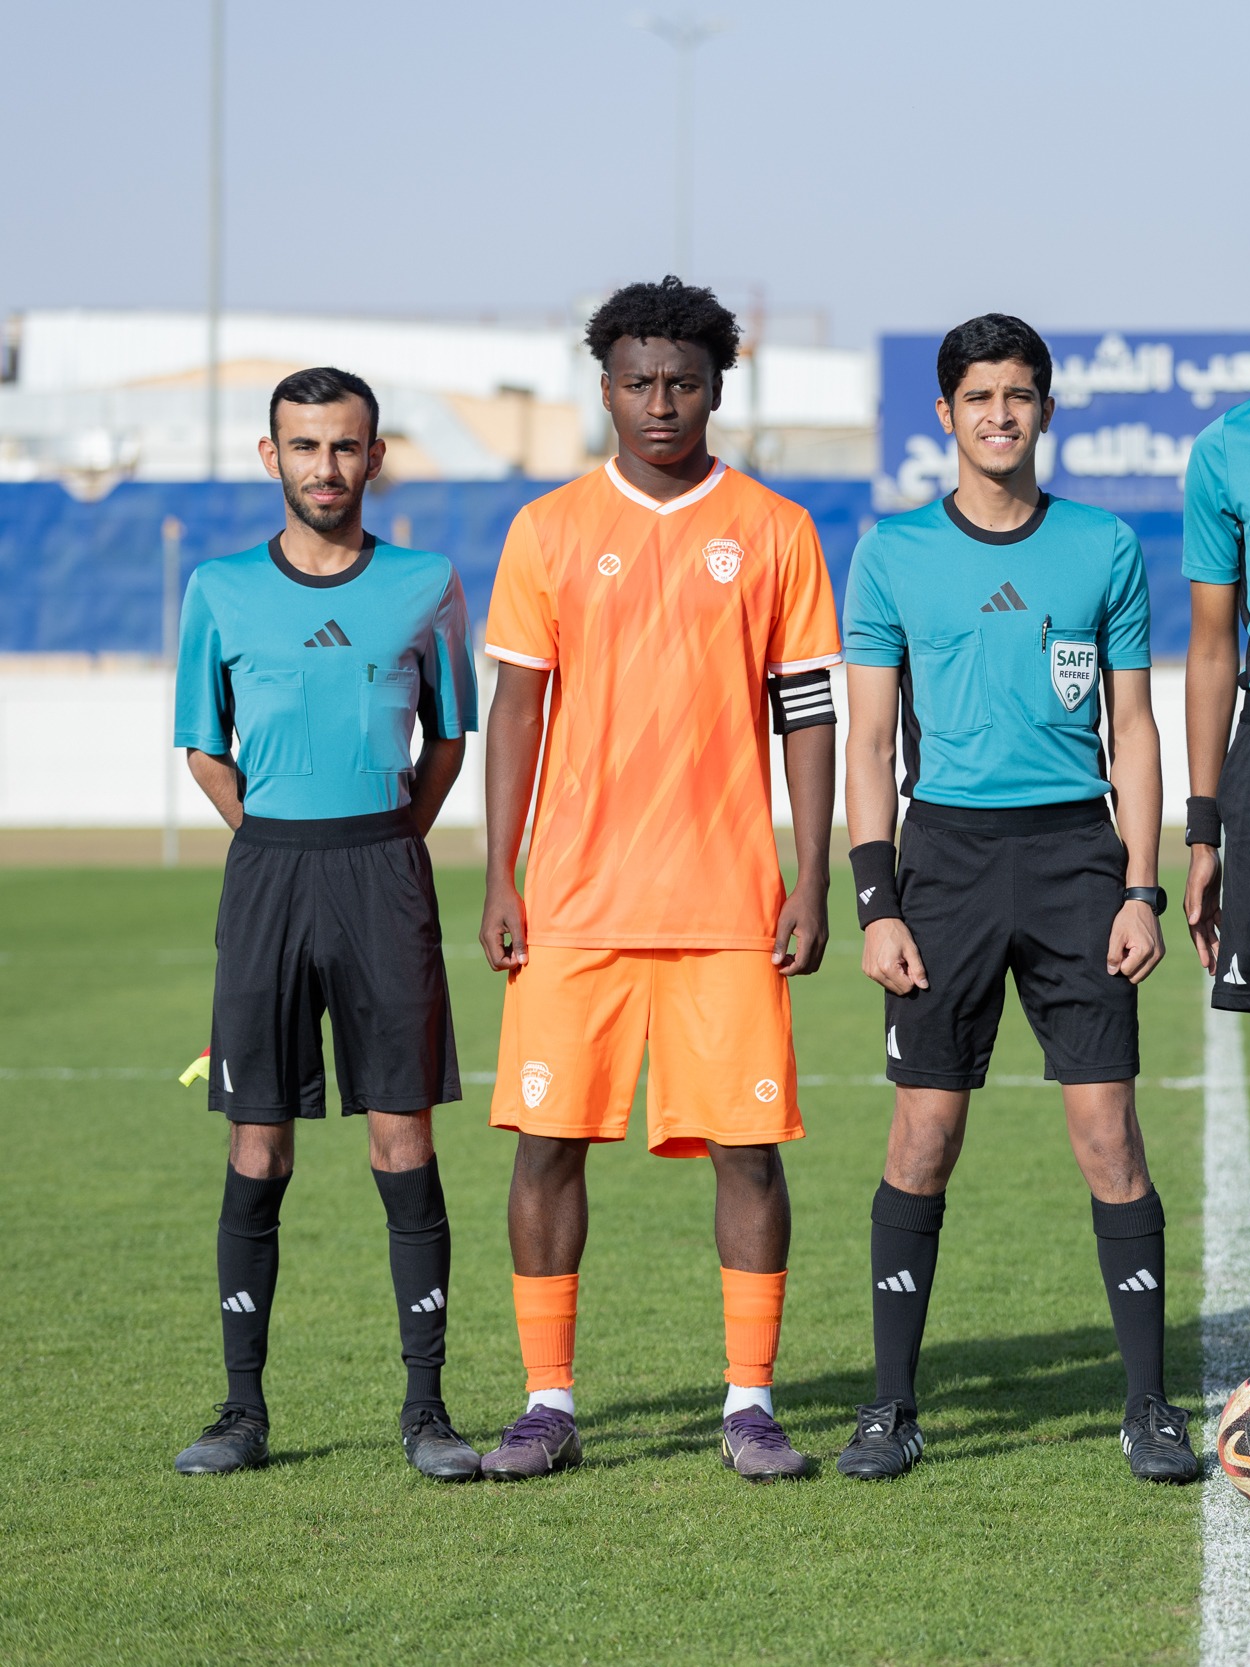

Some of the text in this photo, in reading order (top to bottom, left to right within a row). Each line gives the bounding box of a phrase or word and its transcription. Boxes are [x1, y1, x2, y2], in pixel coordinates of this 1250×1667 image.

[1050, 331, 1175, 410] الشي
[1061, 421, 1193, 492] بدالله
[1056, 649, 1094, 668] SAFF
[1059, 670, 1090, 680] REFEREE
